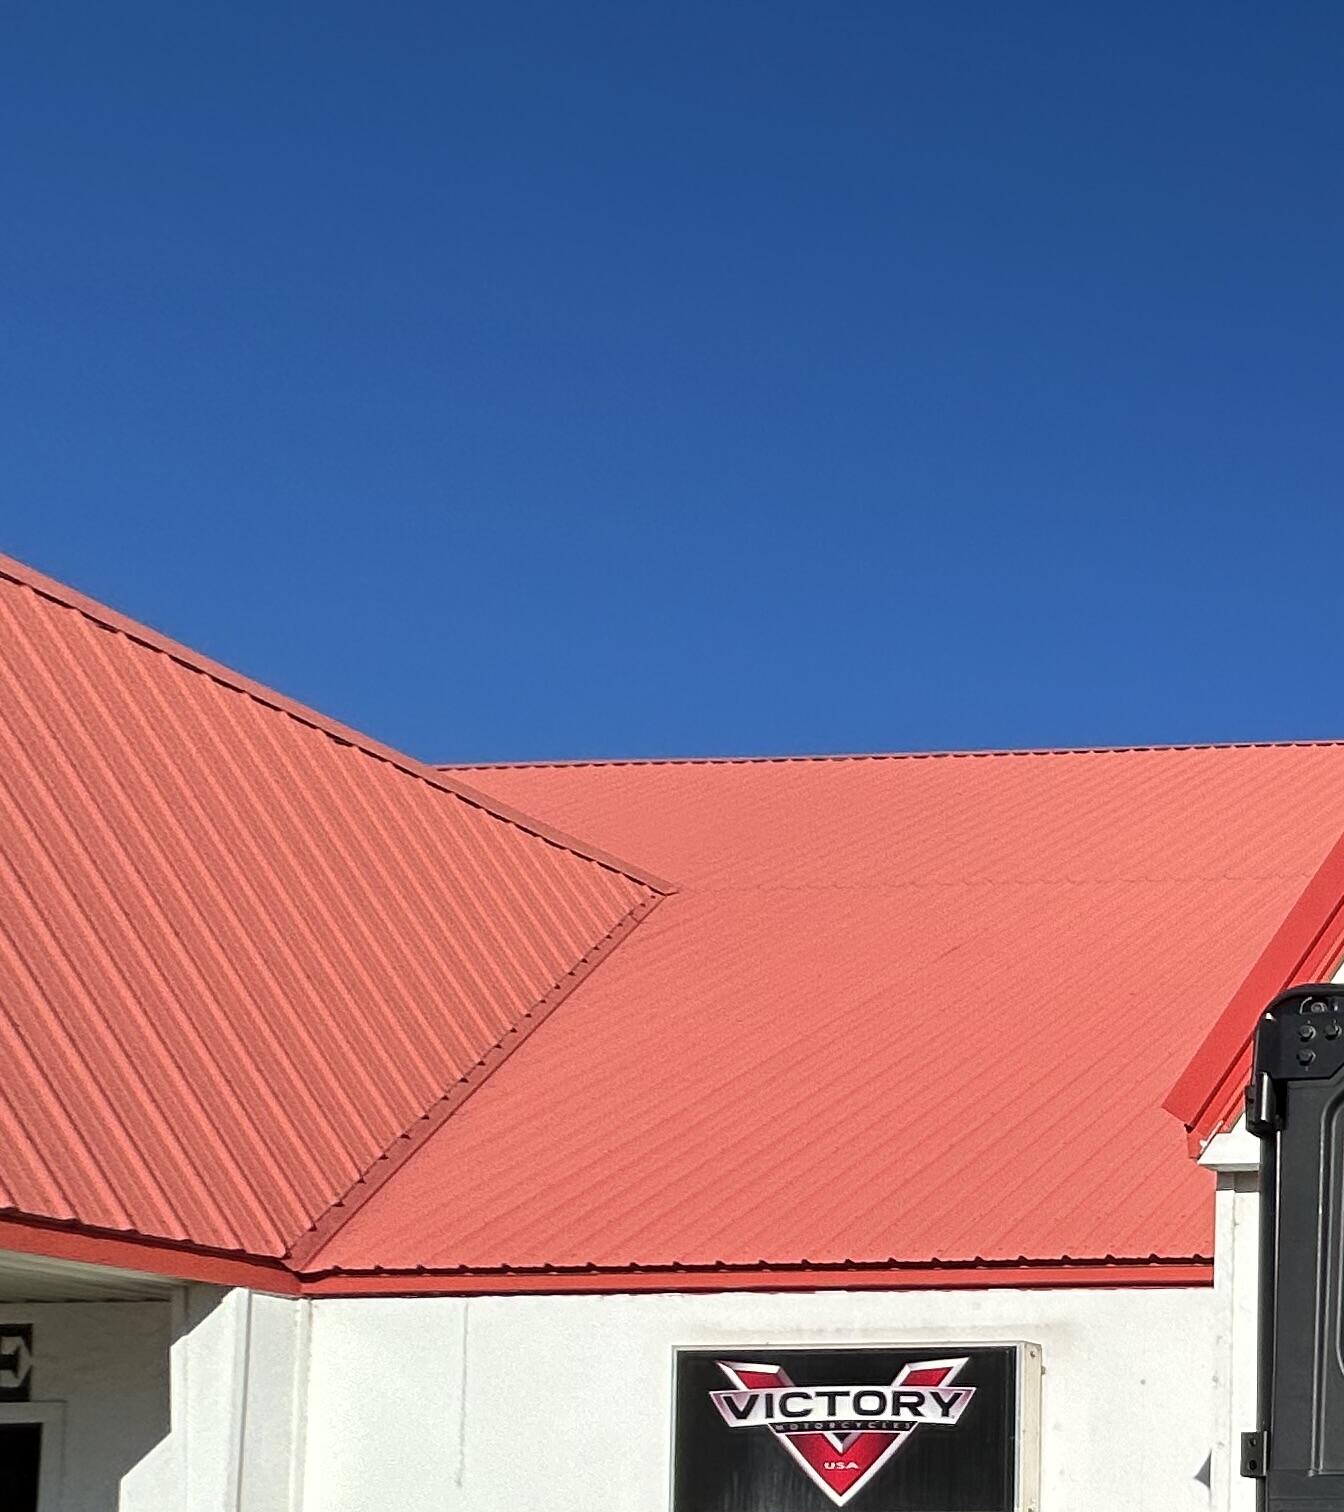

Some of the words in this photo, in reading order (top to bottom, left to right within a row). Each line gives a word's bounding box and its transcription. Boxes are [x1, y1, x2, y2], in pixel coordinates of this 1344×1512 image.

[722, 1390, 964, 1420] VICTORY
[774, 1421, 912, 1432] MOTORCYCLES
[824, 1461, 860, 1470] USA
